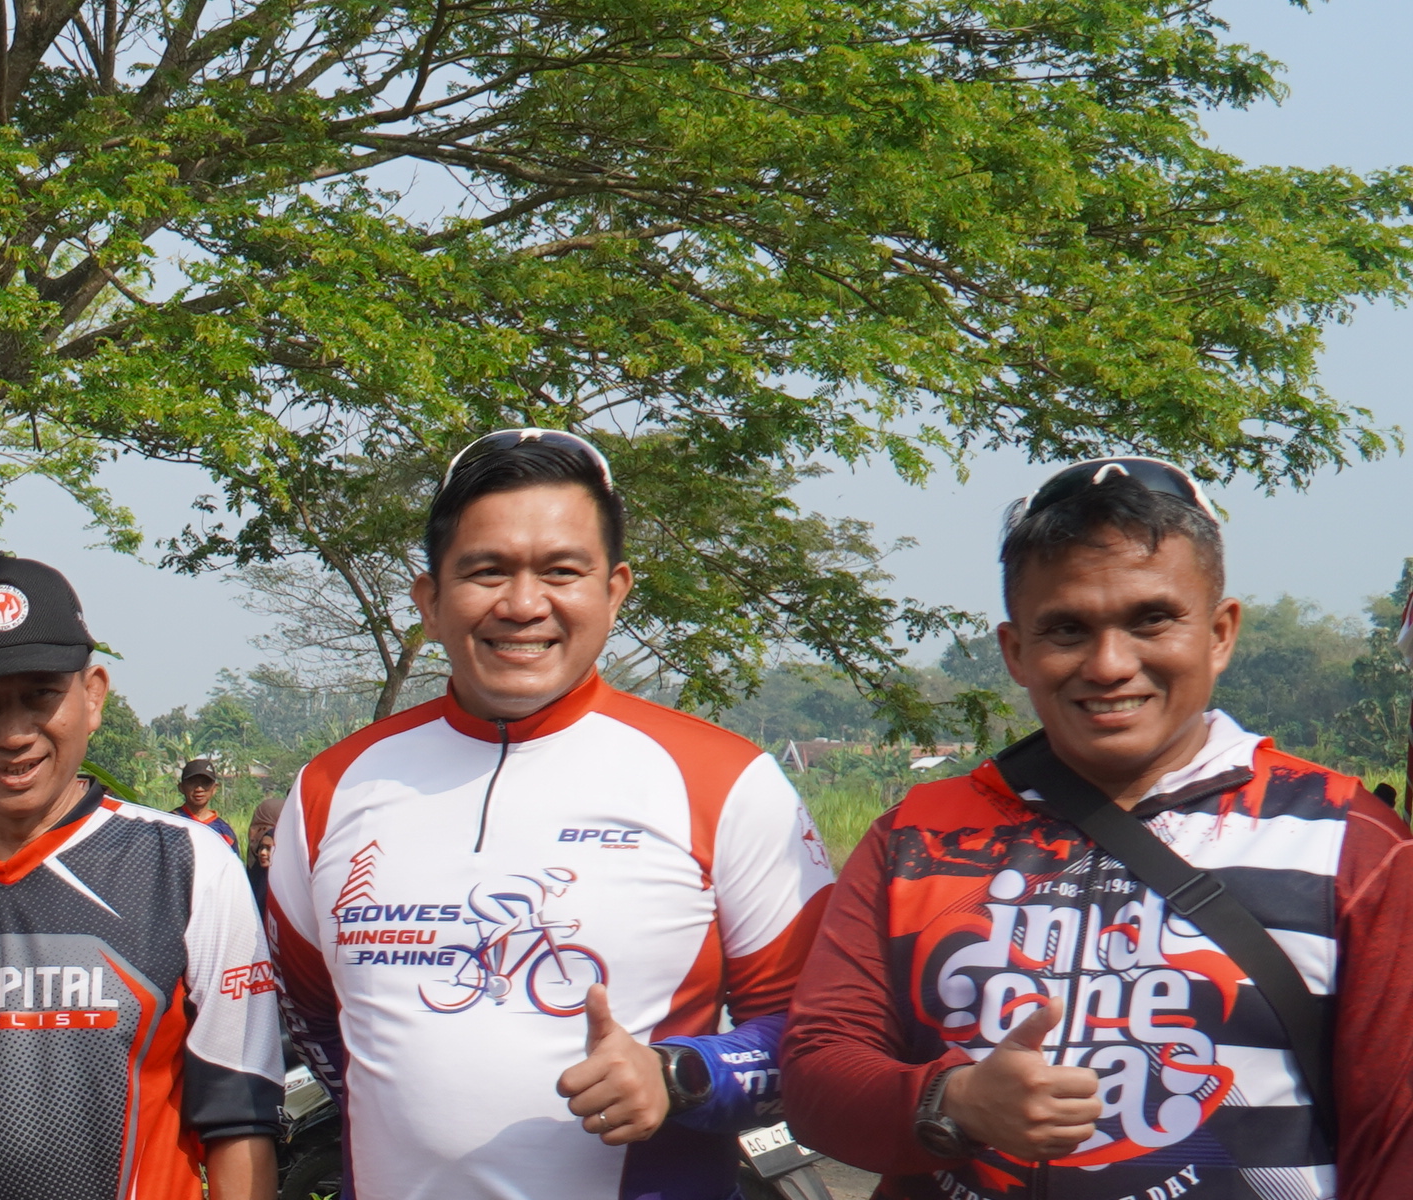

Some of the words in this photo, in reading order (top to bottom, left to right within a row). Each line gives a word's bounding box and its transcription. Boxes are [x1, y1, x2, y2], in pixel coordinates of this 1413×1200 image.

[558, 828, 643, 843] BPCC
[342, 904, 462, 923] GOWES
[339, 929, 436, 945] MINGGU
[357, 949, 457, 966] PAHING
